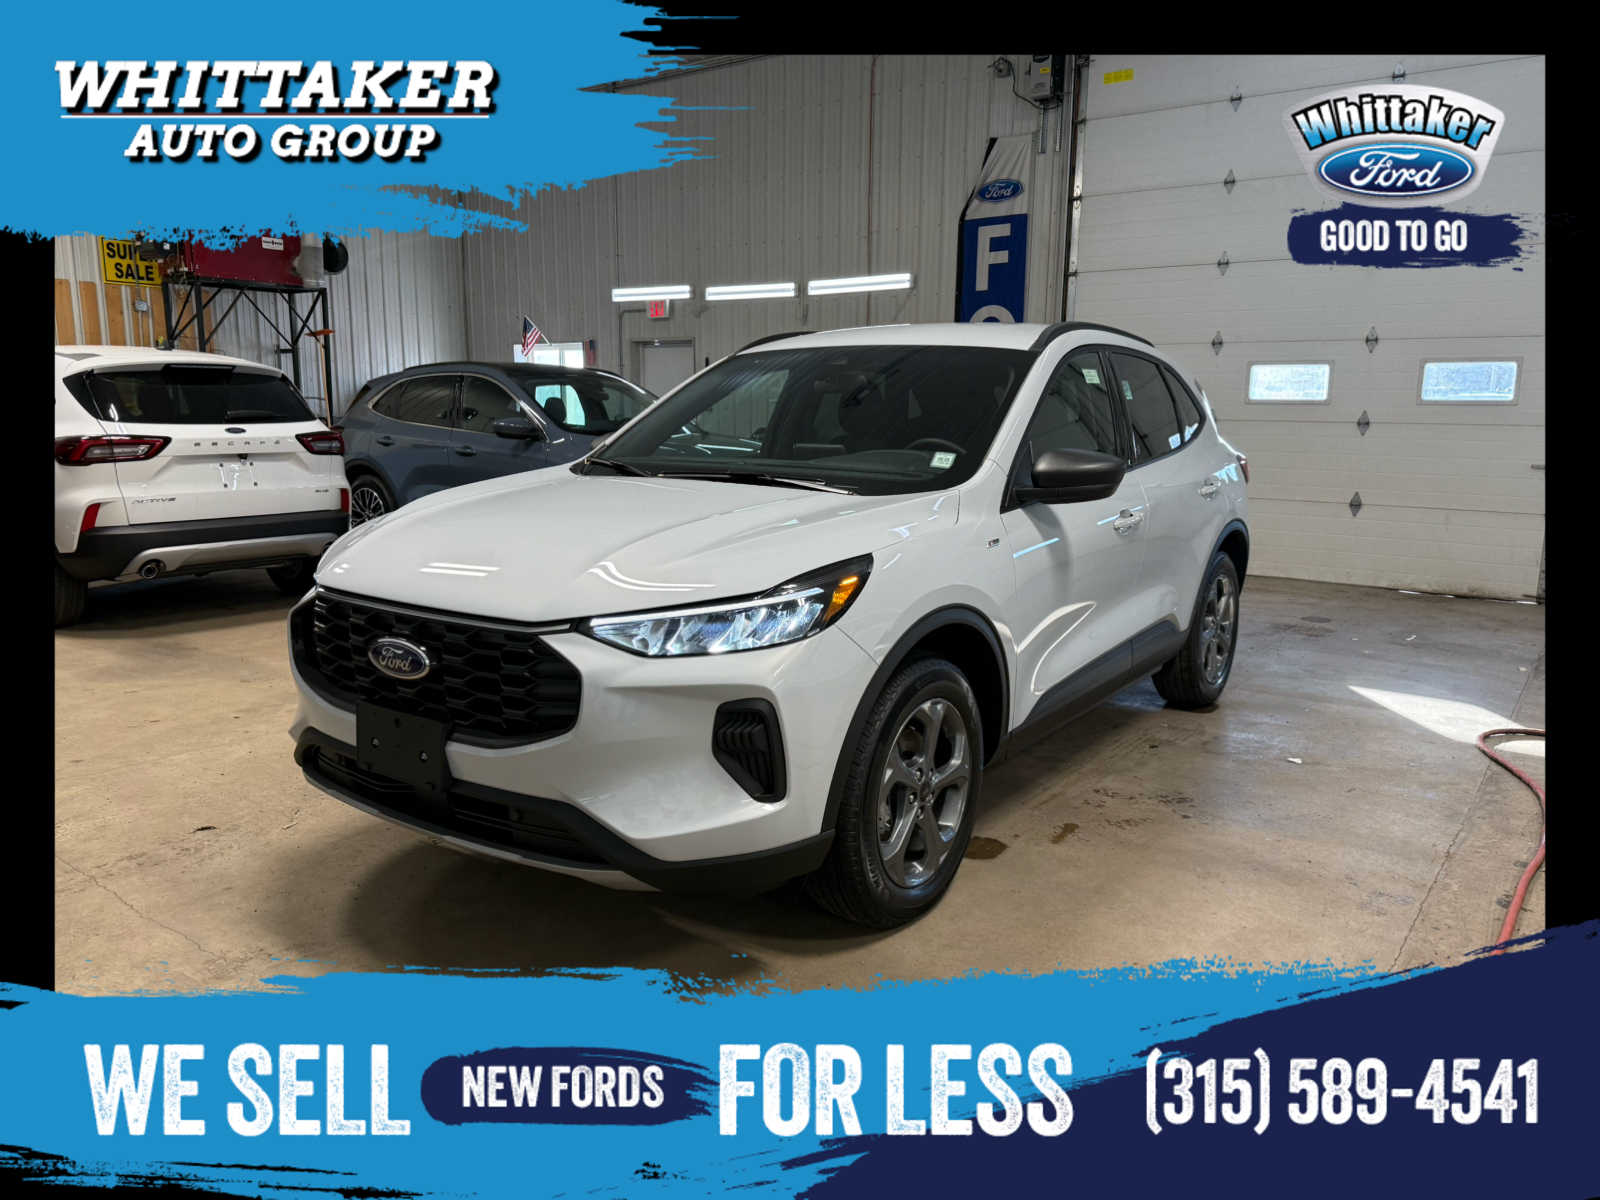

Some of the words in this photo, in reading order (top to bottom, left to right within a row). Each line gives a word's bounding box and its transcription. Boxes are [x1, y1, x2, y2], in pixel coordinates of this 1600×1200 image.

[984, 182, 1015, 199] Ford
[114, 262, 155, 281] SALE
[379, 646, 412, 671] Ford
